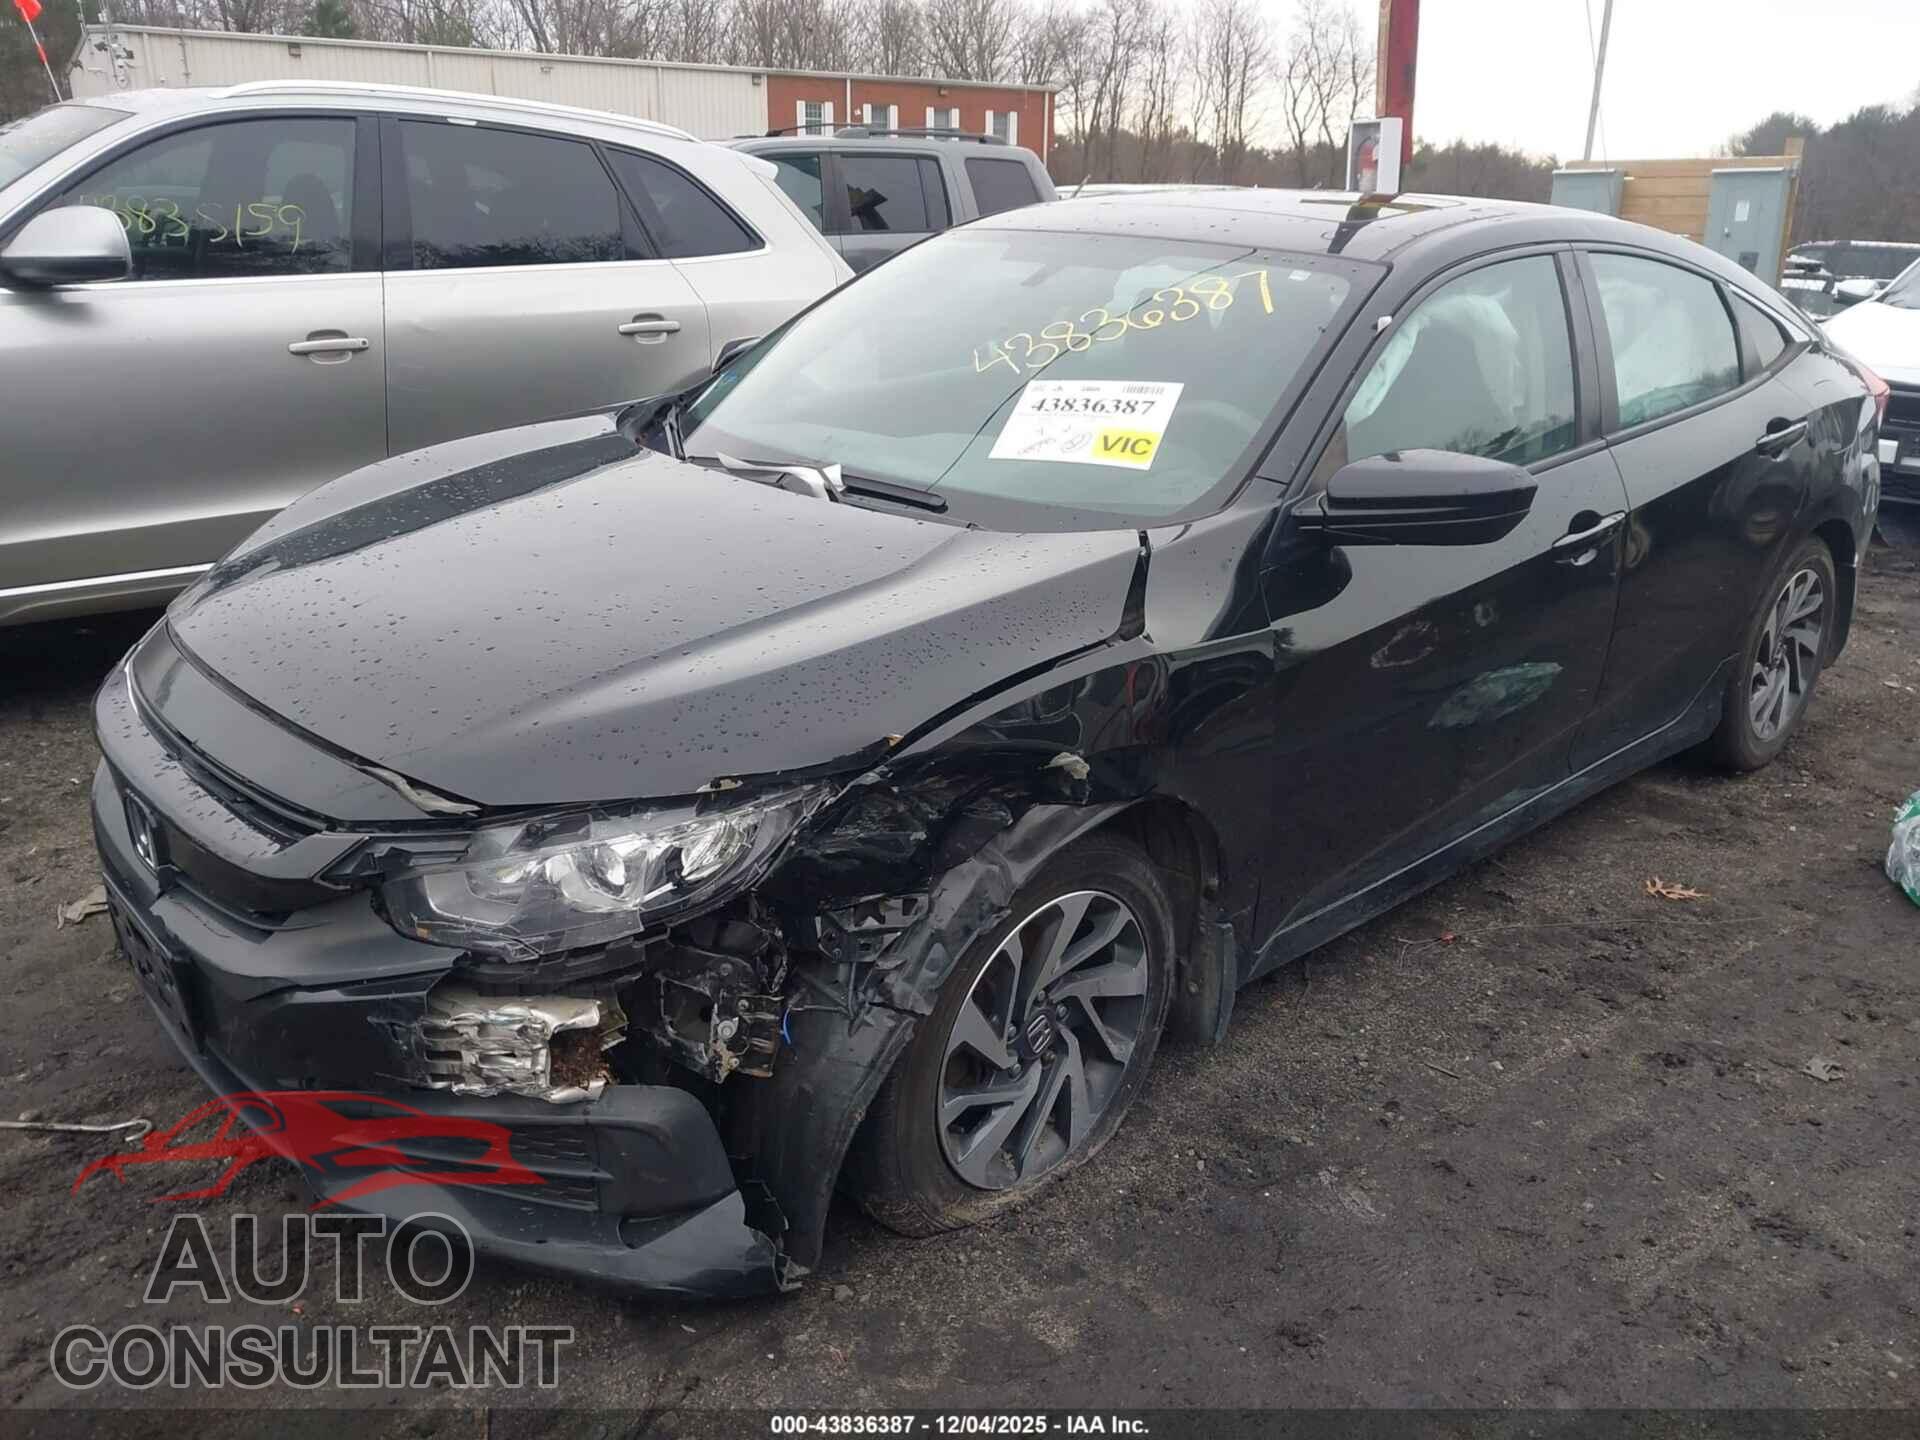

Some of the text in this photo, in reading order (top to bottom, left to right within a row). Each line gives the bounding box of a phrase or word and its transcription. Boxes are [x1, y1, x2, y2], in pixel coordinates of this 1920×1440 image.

[973, 269, 1275, 375] 43836387
[1031, 397, 1156, 416] 43836387
[1102, 434, 1152, 456] VIC
